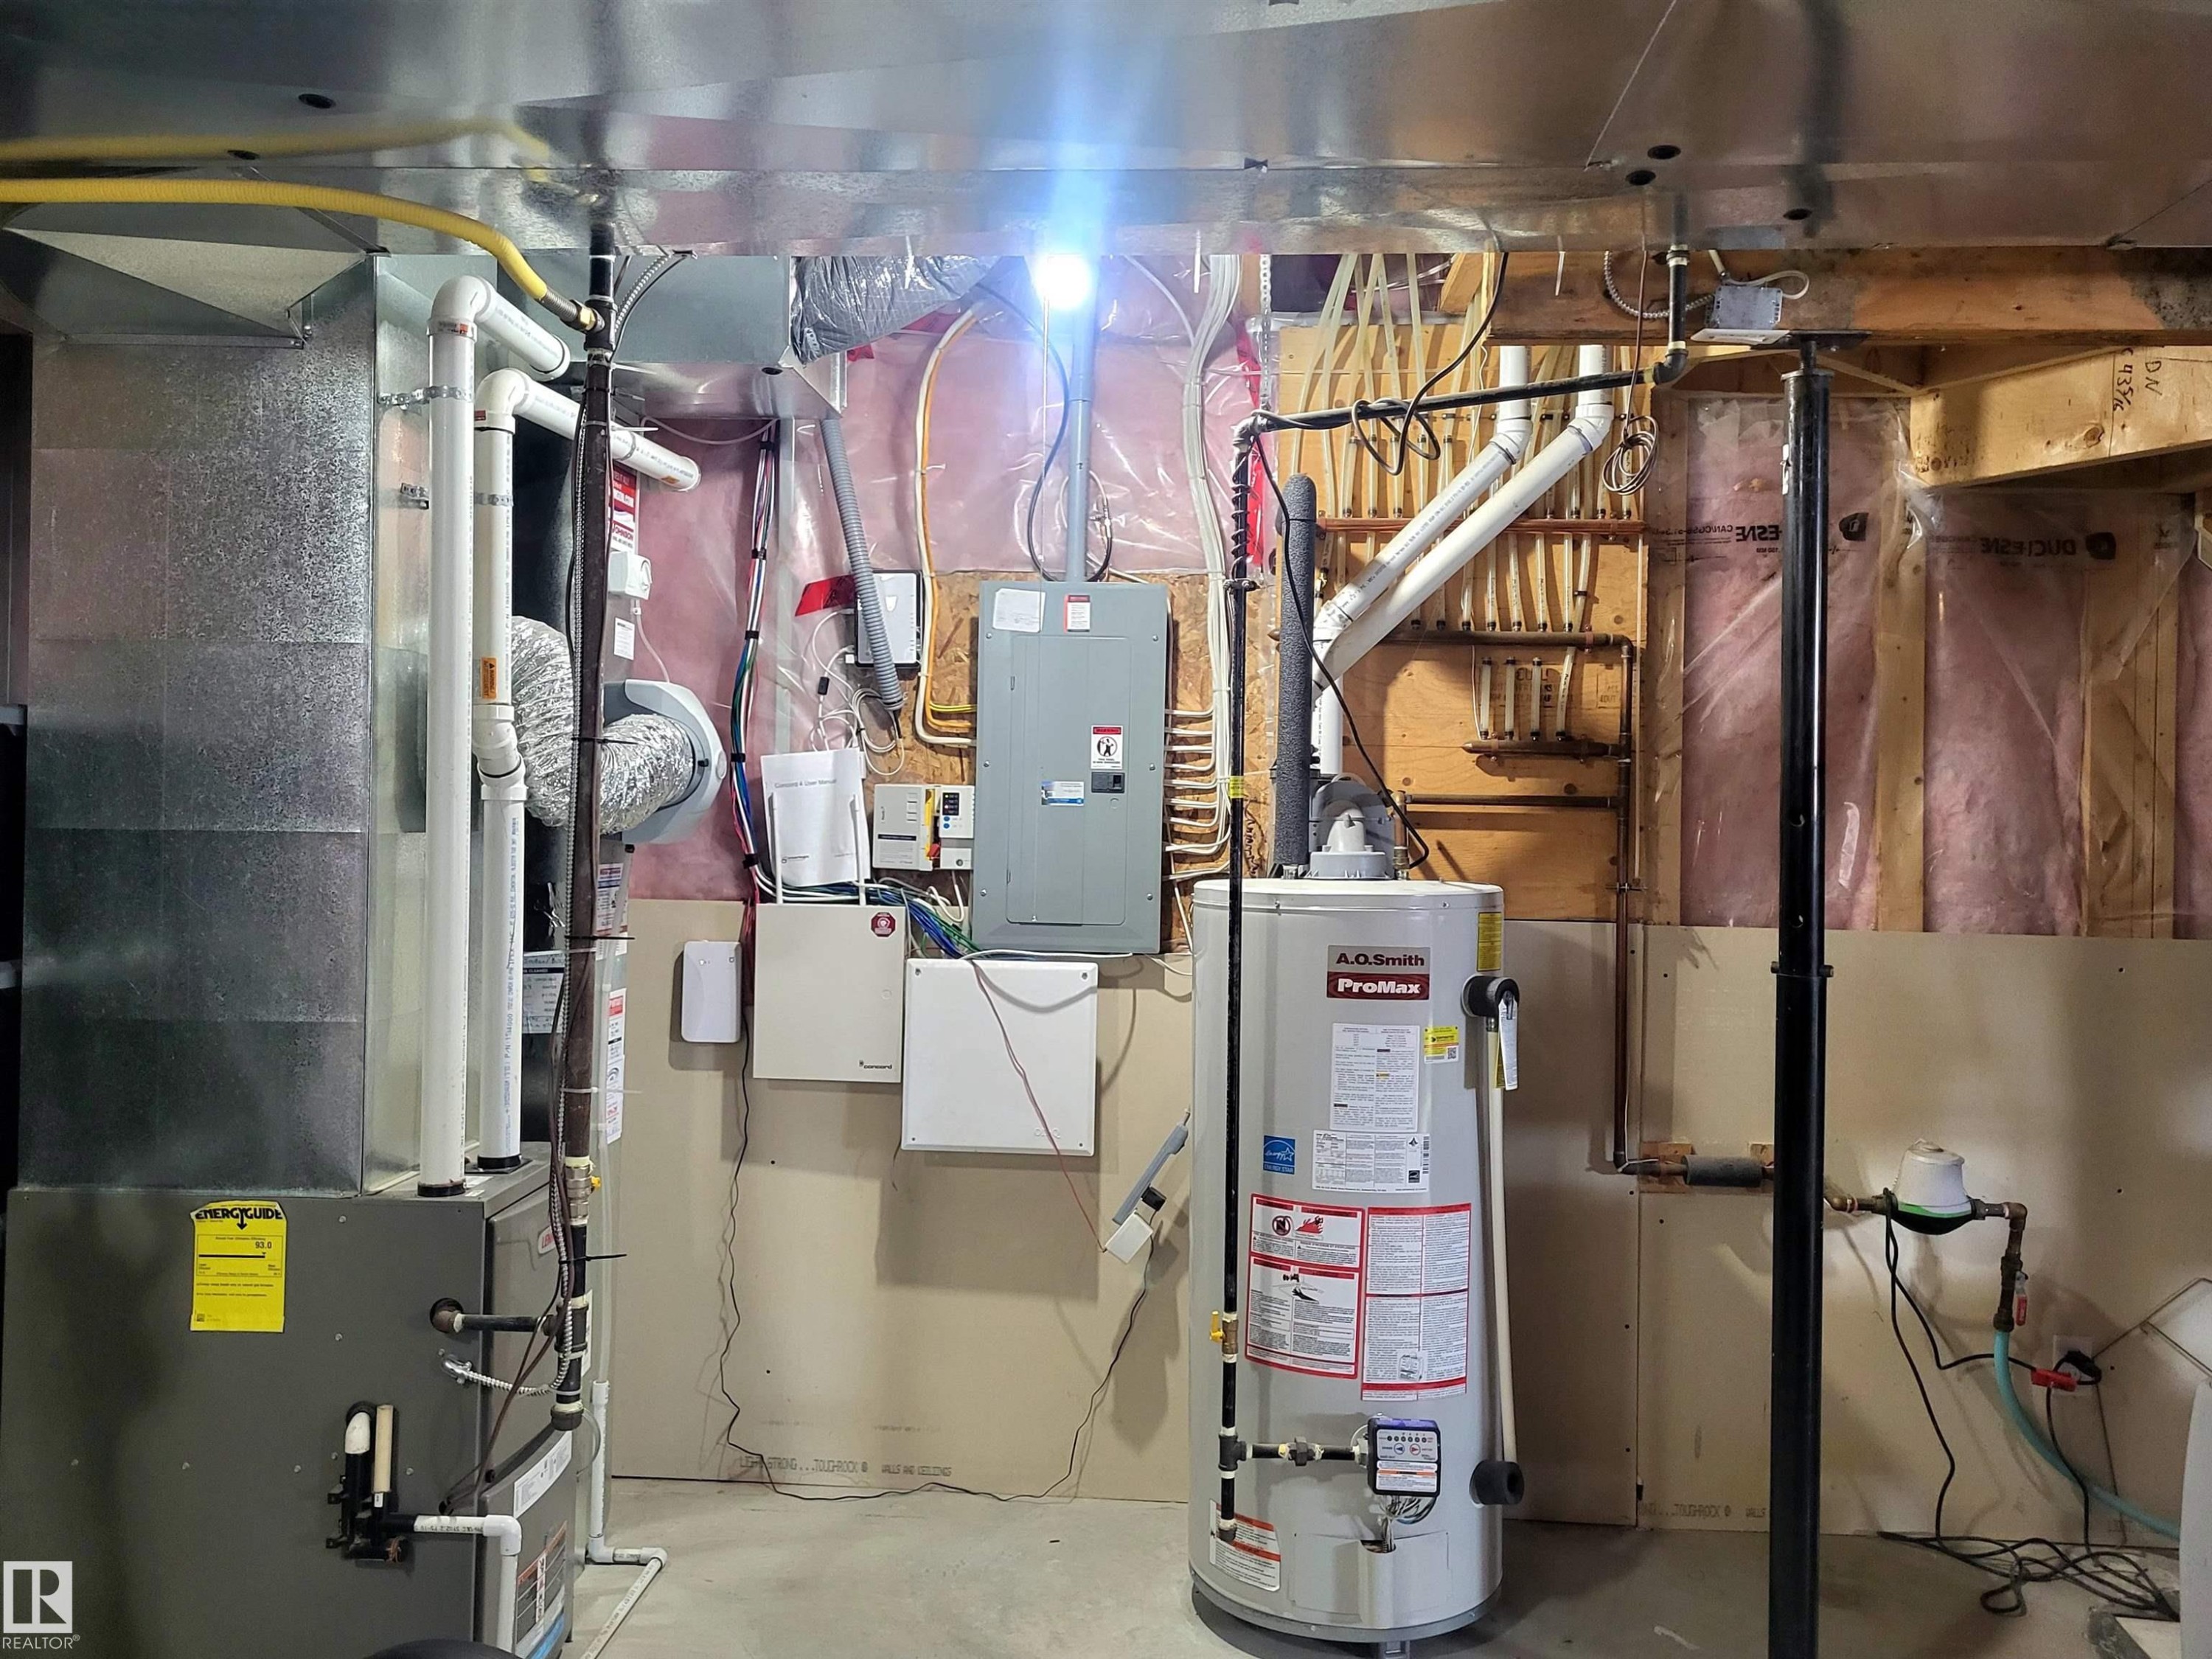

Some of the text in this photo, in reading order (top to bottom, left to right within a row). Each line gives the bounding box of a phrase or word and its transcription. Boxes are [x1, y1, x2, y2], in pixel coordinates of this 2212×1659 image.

[1336, 953, 1425, 966] A.O.Smith
[1338, 978, 1420, 994] ProMax
[195, 1207, 283, 1220] ENERGYGUIDE
[255, 1241, 272, 1249] 93.0
